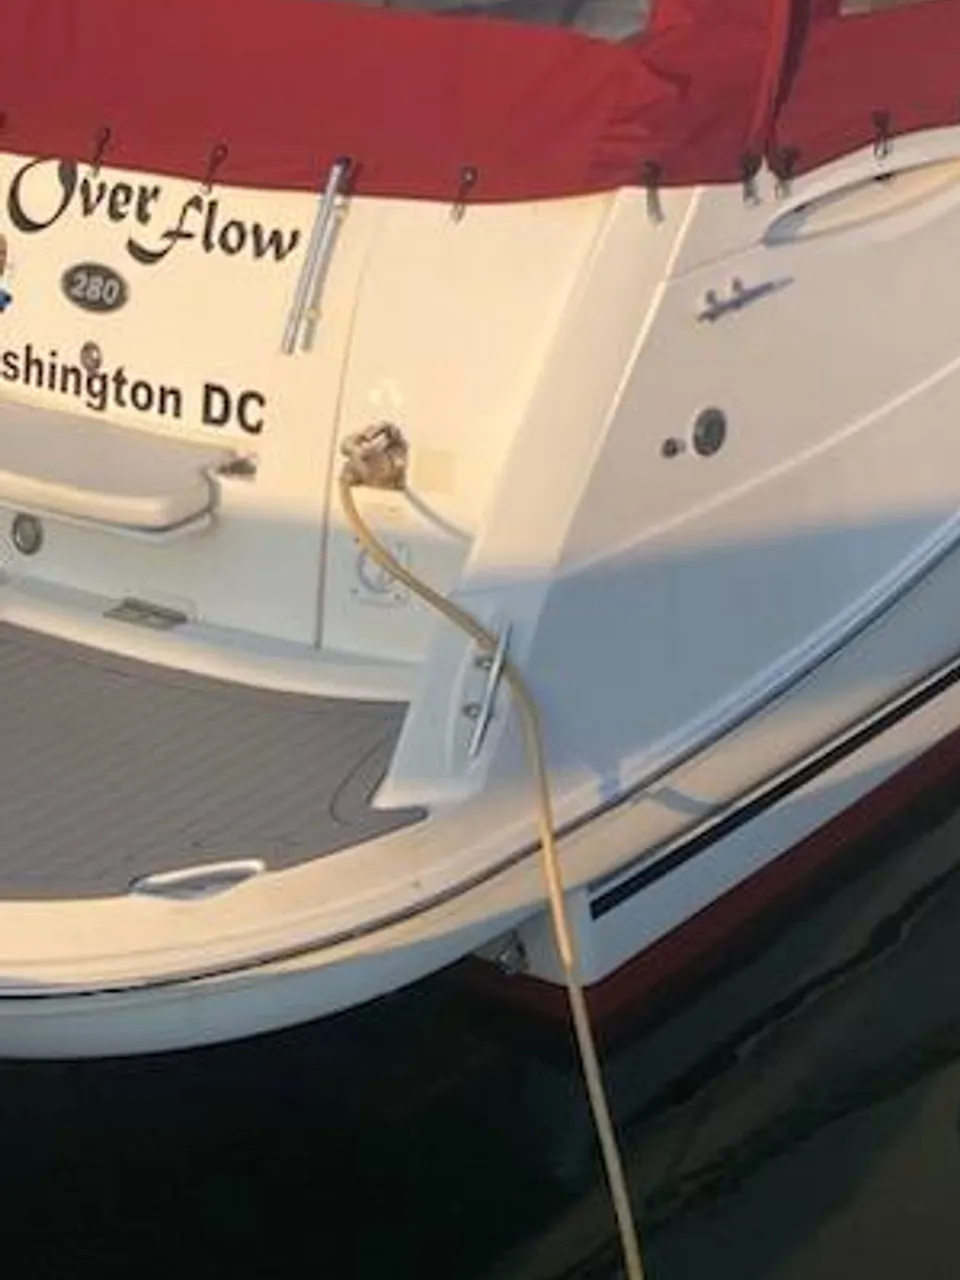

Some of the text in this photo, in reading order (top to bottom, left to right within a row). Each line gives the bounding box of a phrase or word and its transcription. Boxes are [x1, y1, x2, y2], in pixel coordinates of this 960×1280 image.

[7, 158, 160, 233] Over
[70, 271, 120, 305] 280
[202, 382, 266, 434] DC
